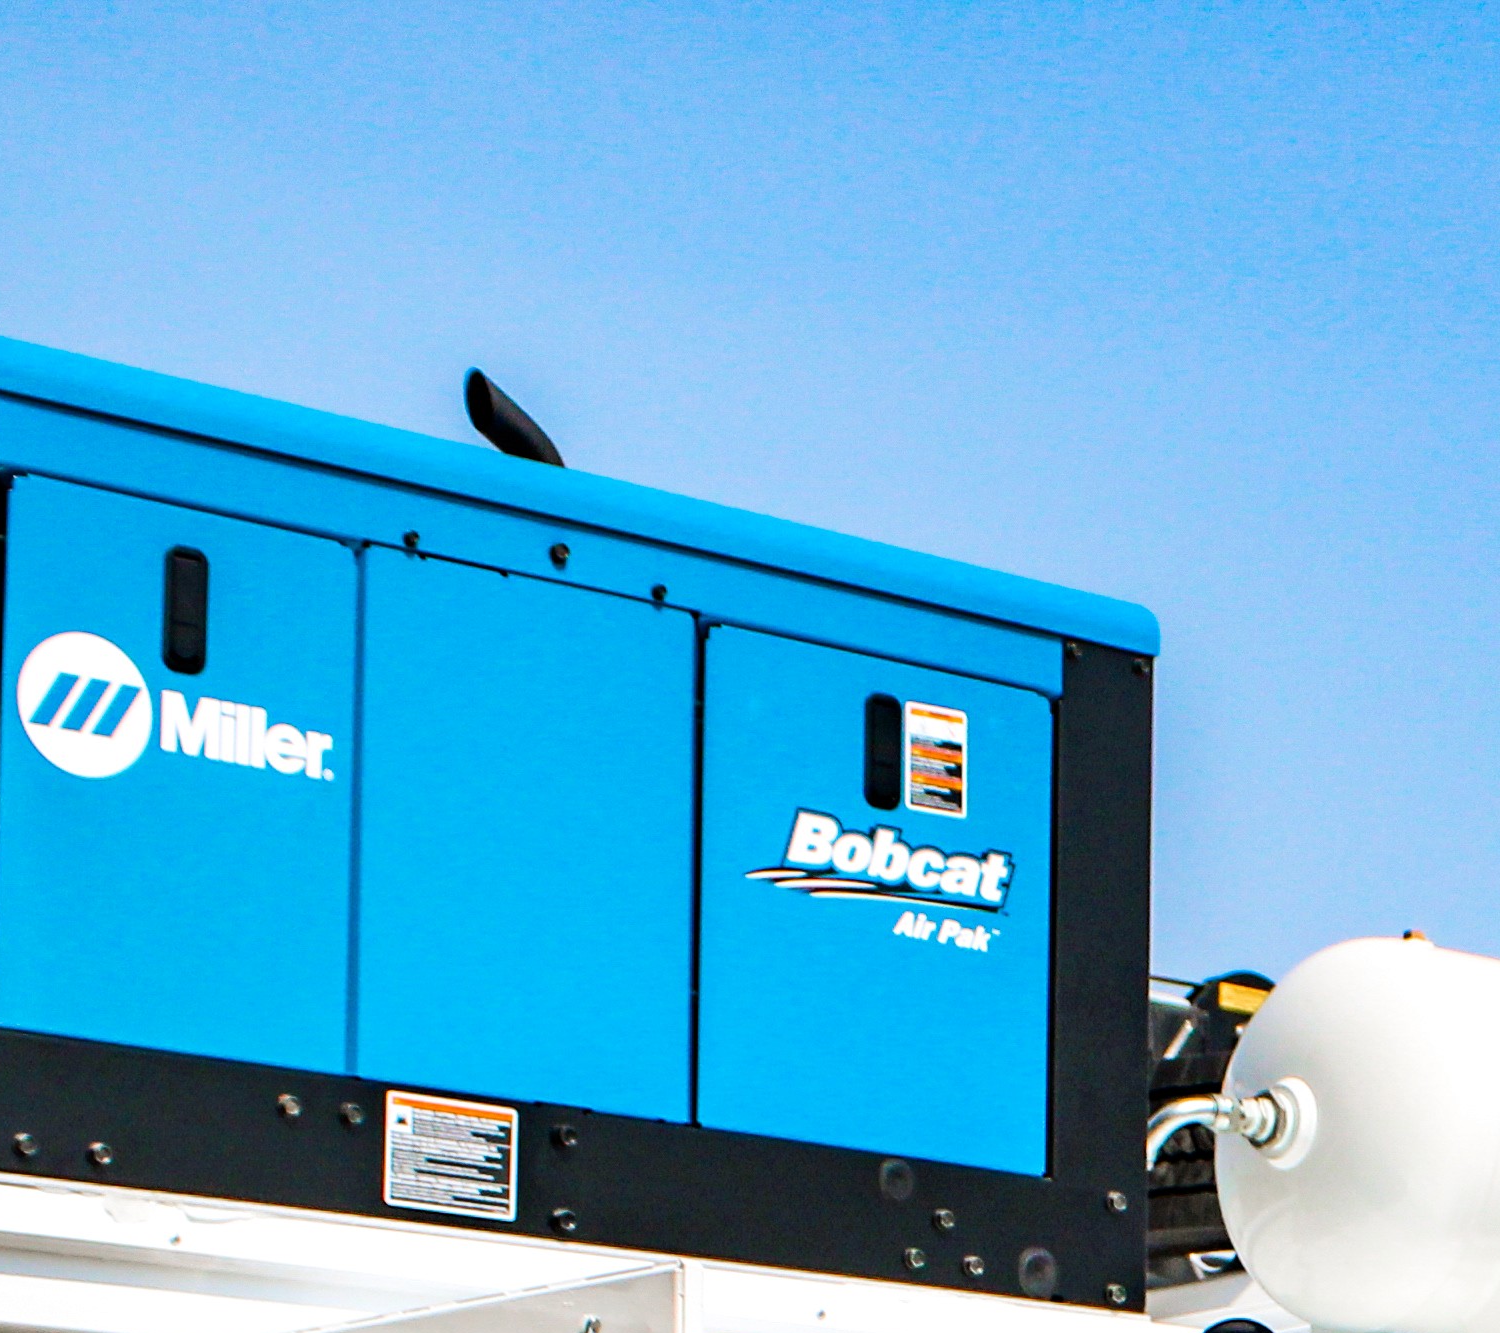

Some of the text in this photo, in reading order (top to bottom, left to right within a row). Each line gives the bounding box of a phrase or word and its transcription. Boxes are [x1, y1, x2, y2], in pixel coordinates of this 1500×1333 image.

[160, 689, 334, 781] Miller
[784, 811, 1010, 902] Bobcat
[893, 911, 937, 941] Air
